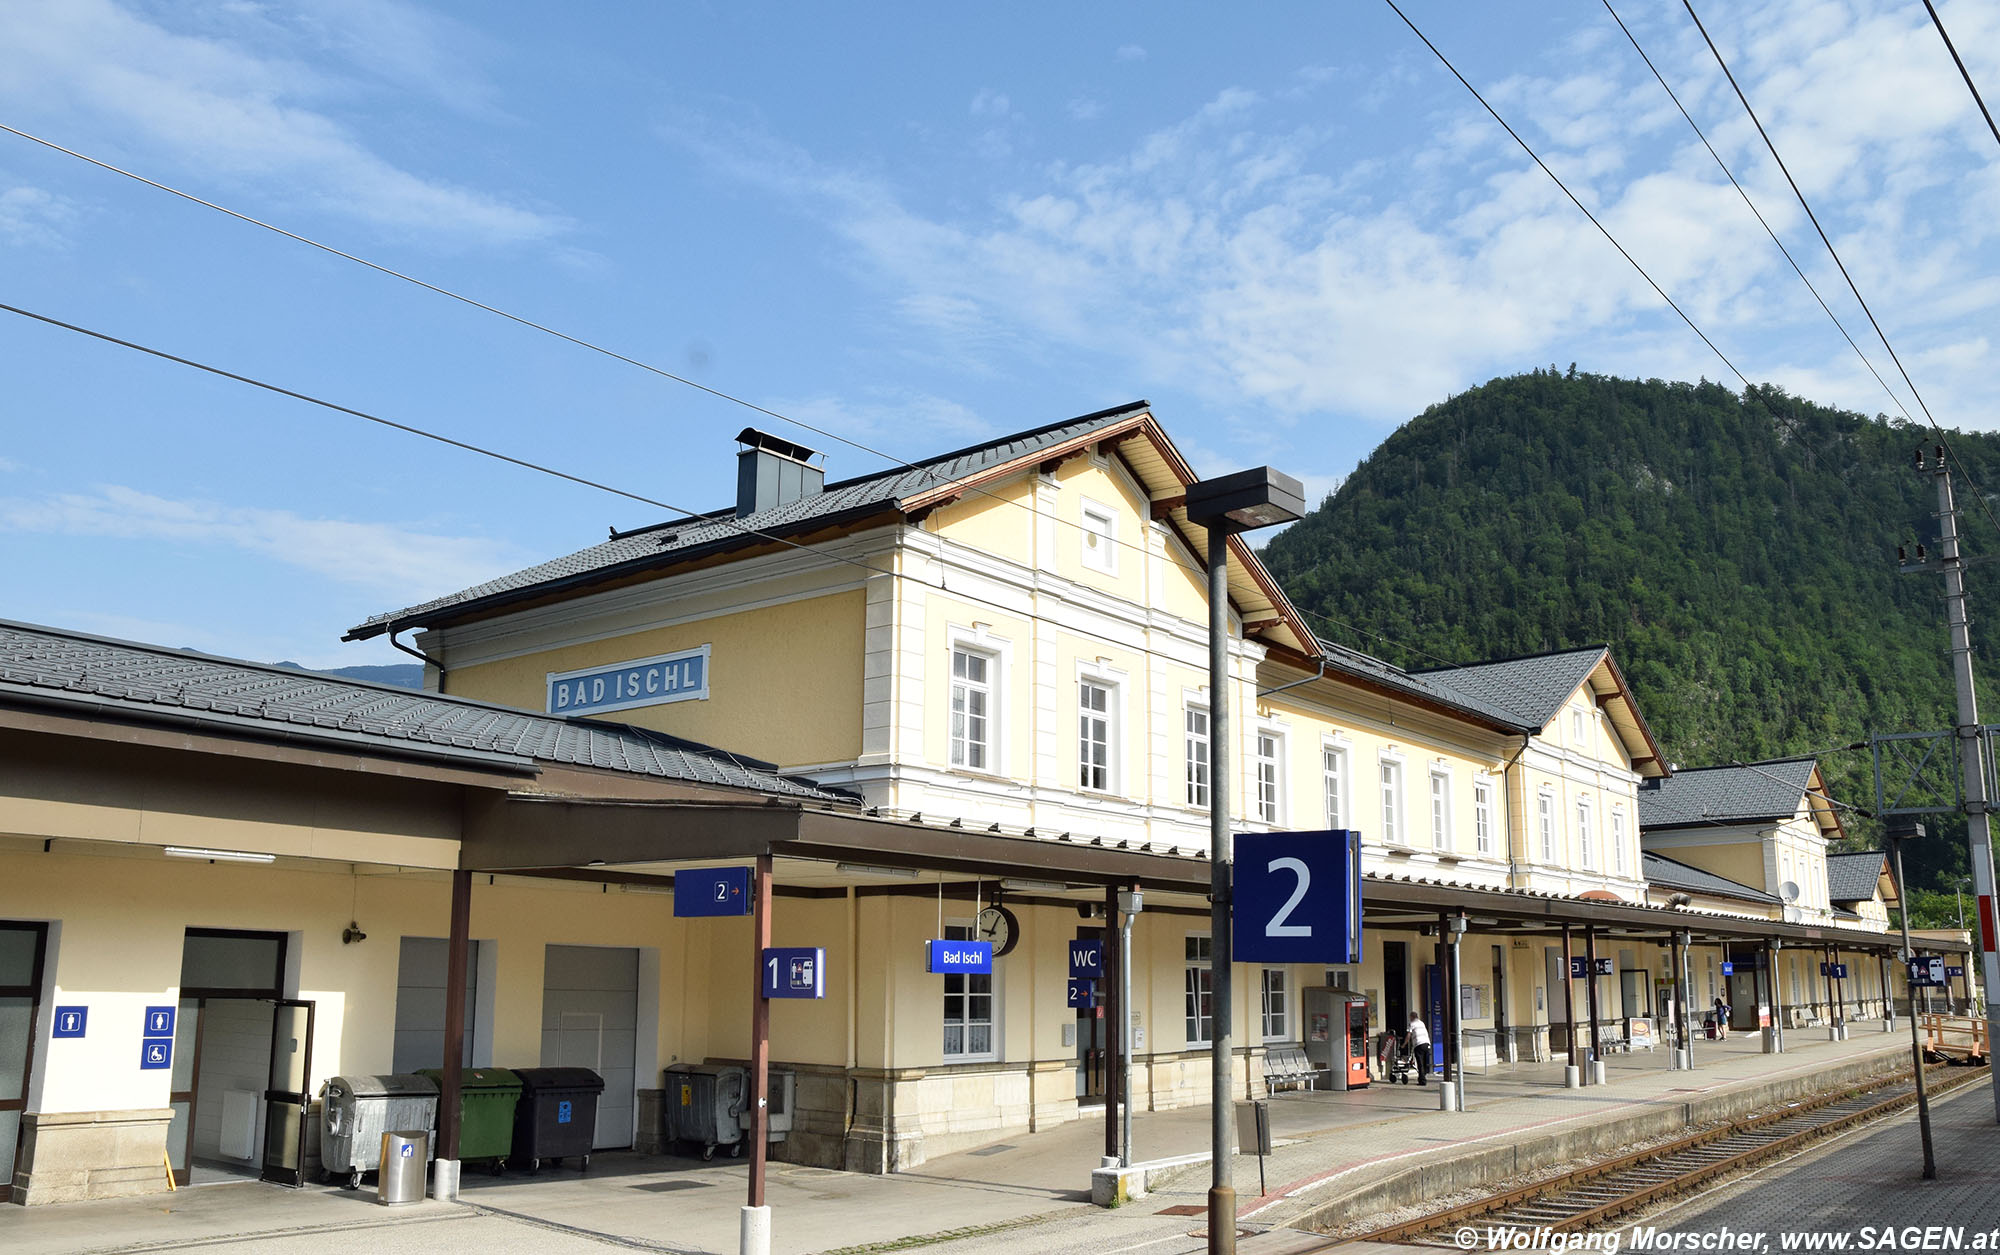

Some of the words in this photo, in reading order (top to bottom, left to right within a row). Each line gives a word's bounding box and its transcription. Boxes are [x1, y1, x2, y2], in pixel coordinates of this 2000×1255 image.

[557, 678, 605, 708] BAD
[616, 662, 696, 699] ISCHL
[717, 883, 726, 900] 2
[1265, 856, 1312, 937] 2
[943, 950, 960, 964] Bad
[962, 951, 983, 964] Ischl
[1073, 950, 1097, 967] WC
[768, 957, 778, 989] 1
[1836, 966, 1842, 976] 1
[1069, 987, 1078, 1000] 2
